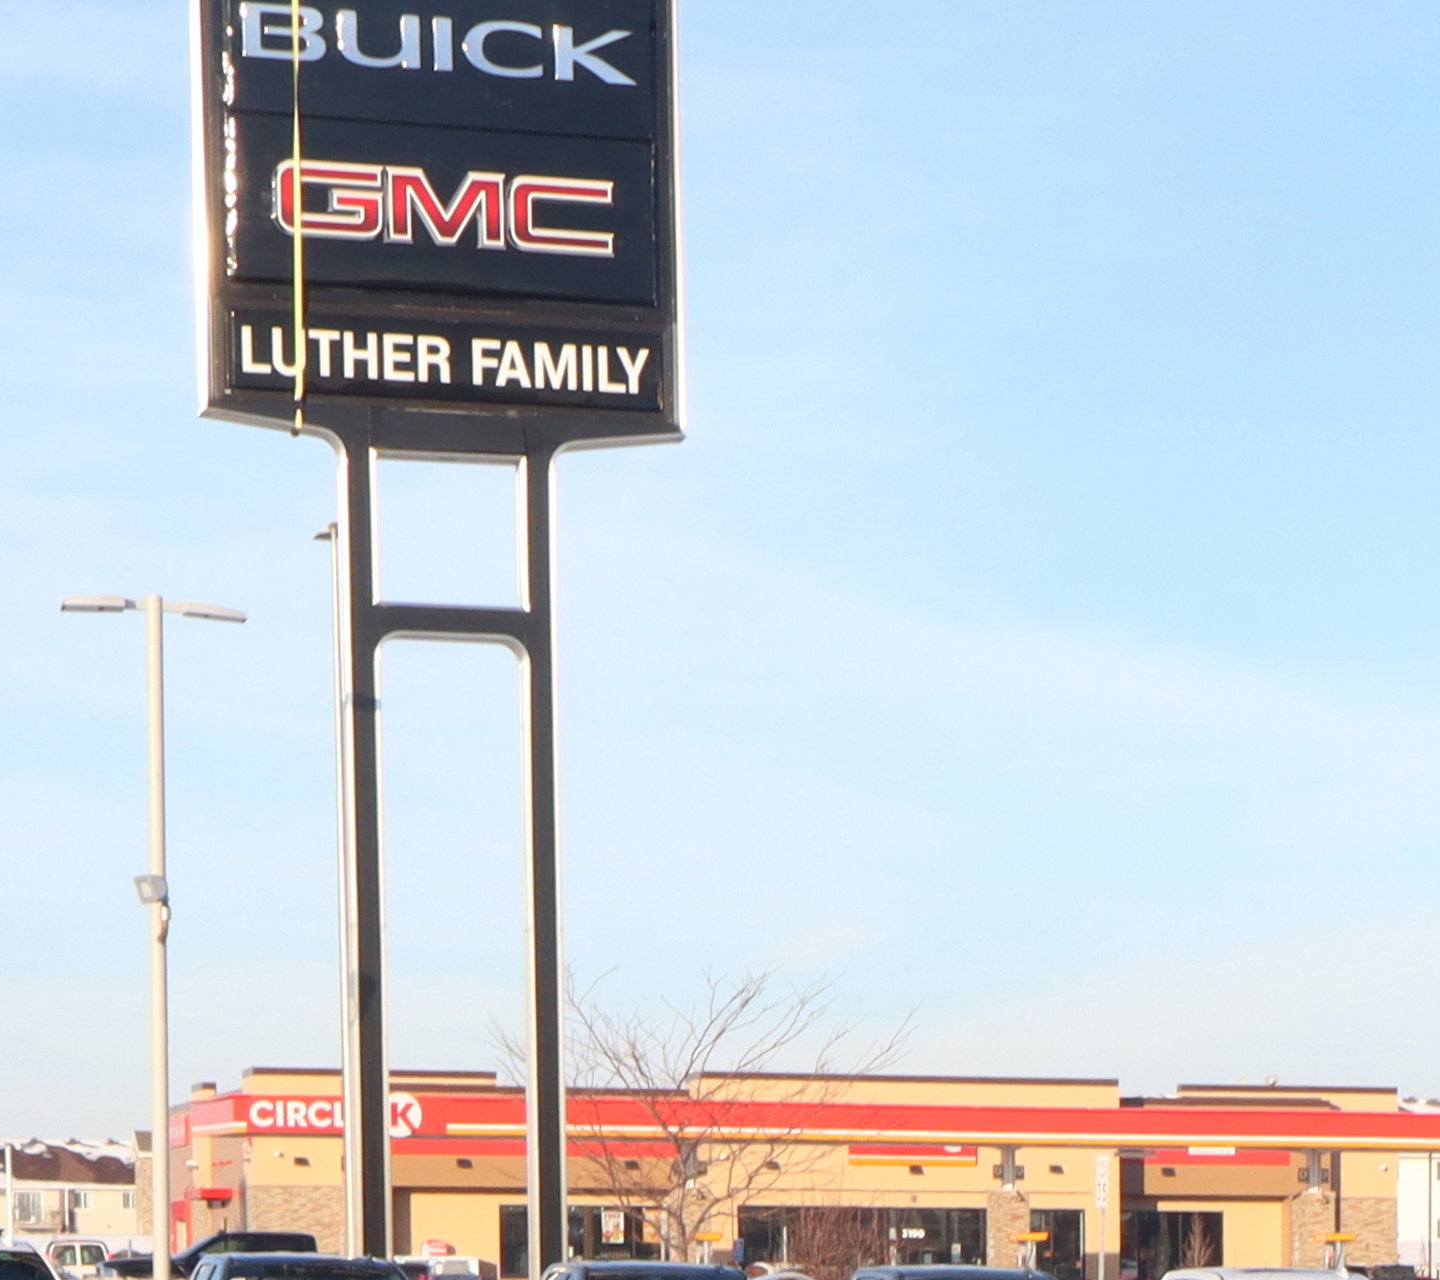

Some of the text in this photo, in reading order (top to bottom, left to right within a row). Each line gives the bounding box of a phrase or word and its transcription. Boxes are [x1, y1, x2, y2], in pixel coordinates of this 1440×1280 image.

[241, 1, 638, 87] BUICK
[272, 158, 615, 258] GMC
[241, 324, 650, 395] LUTHER FAMILY
[249, 1100, 345, 1128] CIRCL
